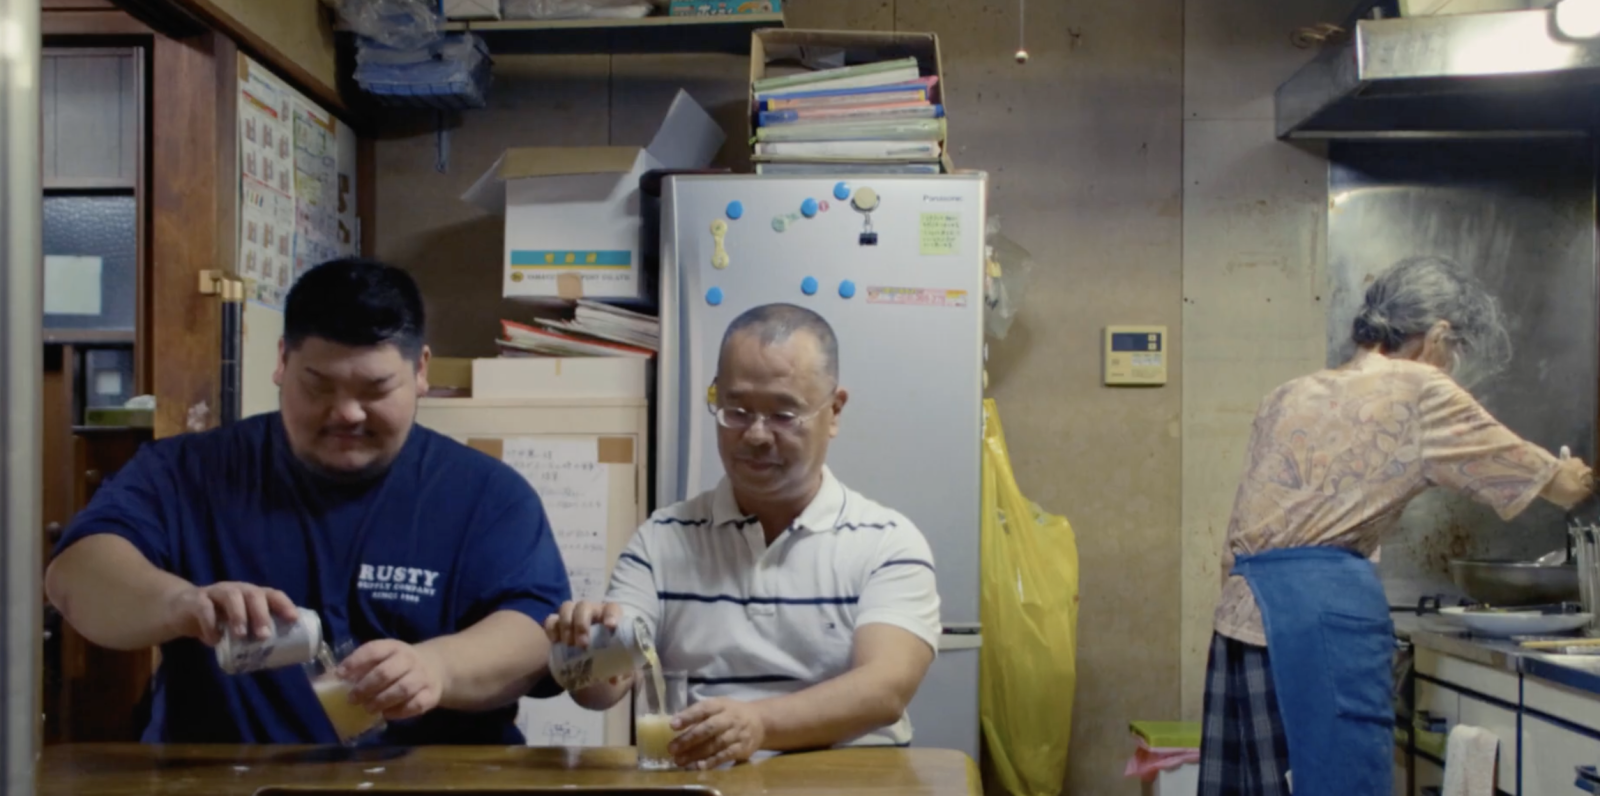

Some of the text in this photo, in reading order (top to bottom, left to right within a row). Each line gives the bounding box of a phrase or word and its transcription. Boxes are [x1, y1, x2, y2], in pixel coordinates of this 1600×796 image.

[359, 564, 439, 587] RUSTY
[357, 581, 436, 596] SUPPLY COMPANY
